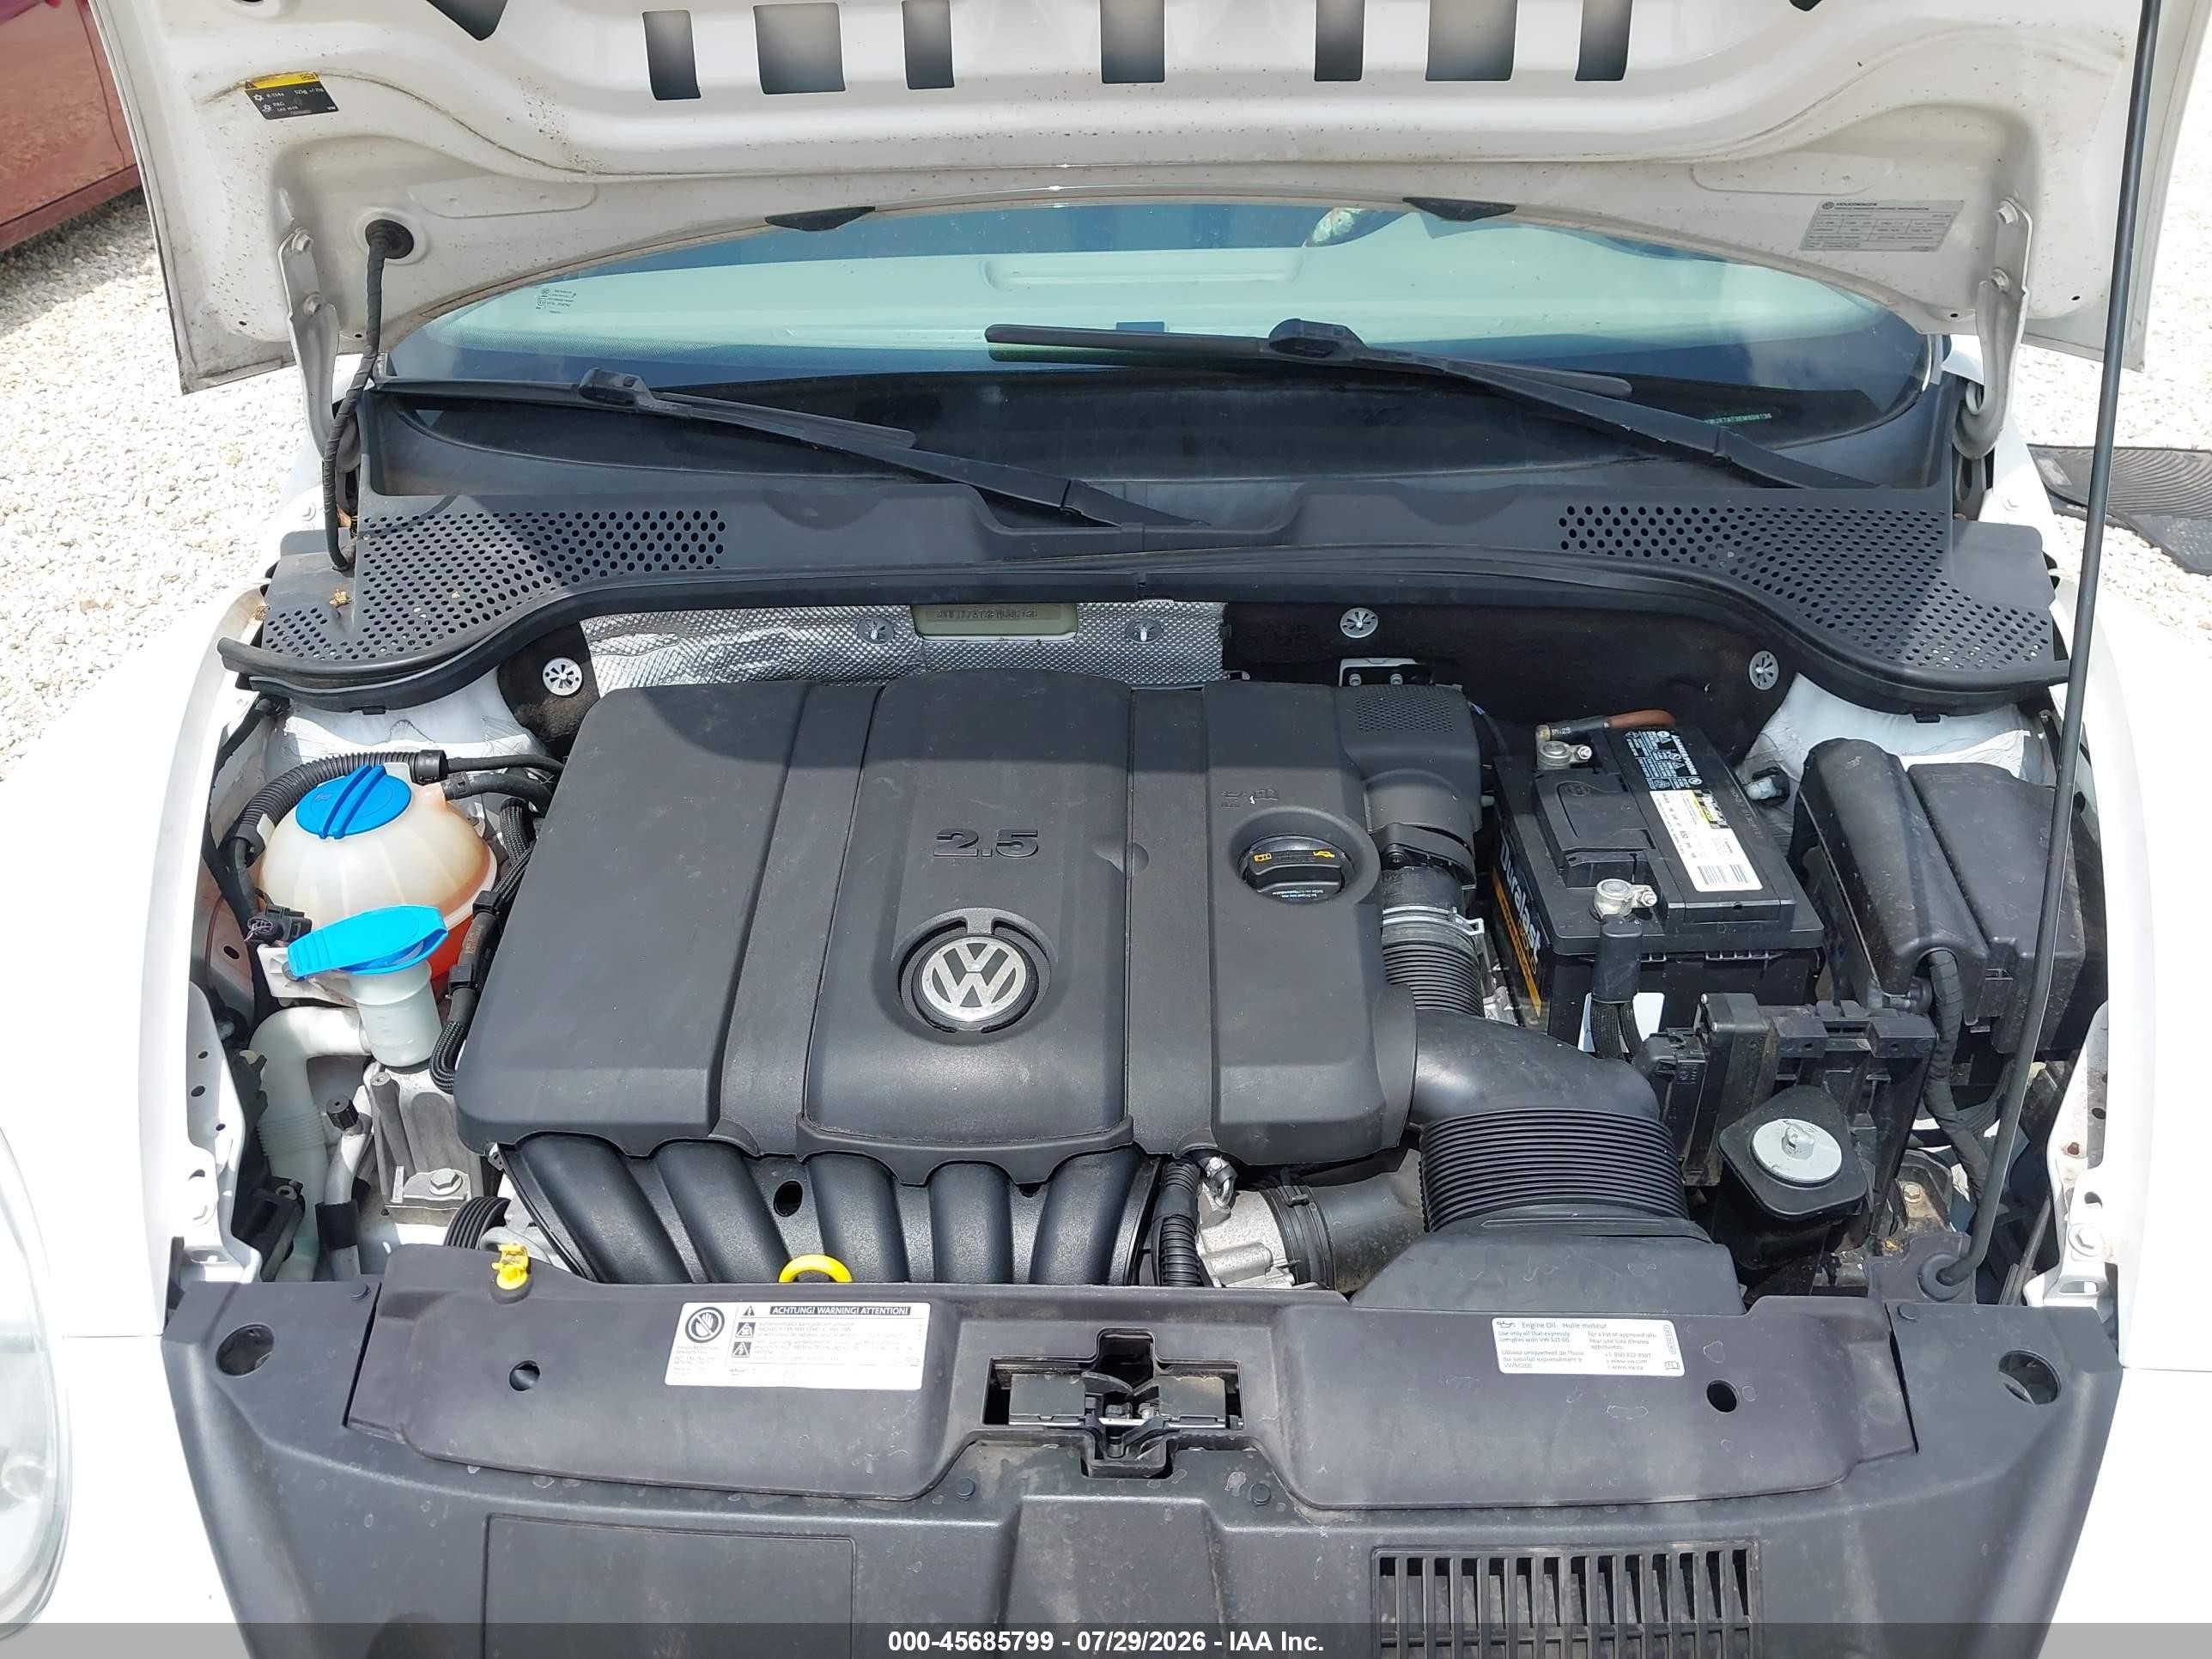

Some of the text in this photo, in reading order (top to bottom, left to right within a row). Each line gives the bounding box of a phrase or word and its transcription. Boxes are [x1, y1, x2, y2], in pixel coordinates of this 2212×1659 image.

[933, 828, 1039, 858] 2.5
[1499, 830, 1541, 967] Duralast
[772, 1306, 815, 1315] ACHTUNG!
[860, 1307, 909, 1316] ATTENTION!
